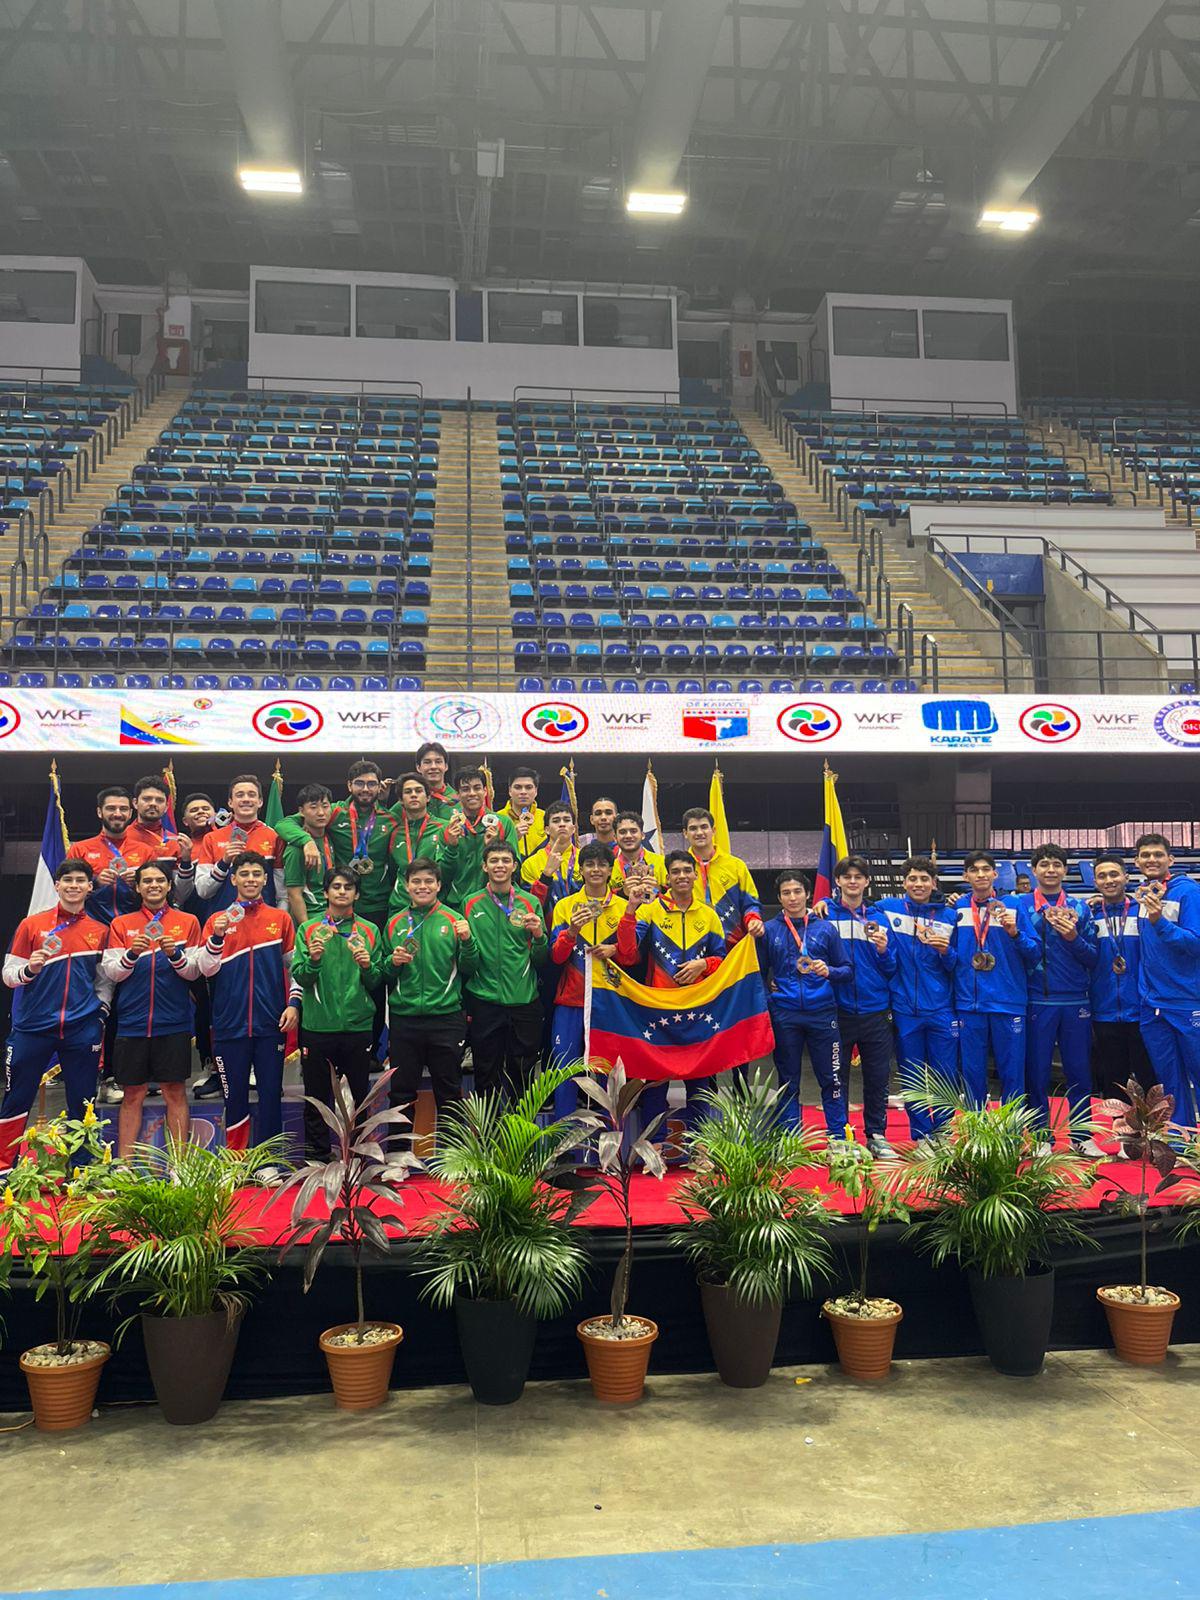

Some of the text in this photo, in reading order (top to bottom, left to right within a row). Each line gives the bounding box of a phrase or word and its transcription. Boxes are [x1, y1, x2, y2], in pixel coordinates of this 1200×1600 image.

[35, 709, 92, 720] WKF
[337, 711, 391, 722] WKF
[602, 712, 651, 723] WKF
[854, 712, 903, 723] WKF
[1092, 714, 1139, 724] WKF
[1183, 723, 1200, 731] DK
[930, 735, 992, 743] KARATE
[215, 1056, 226, 1073] RICA
